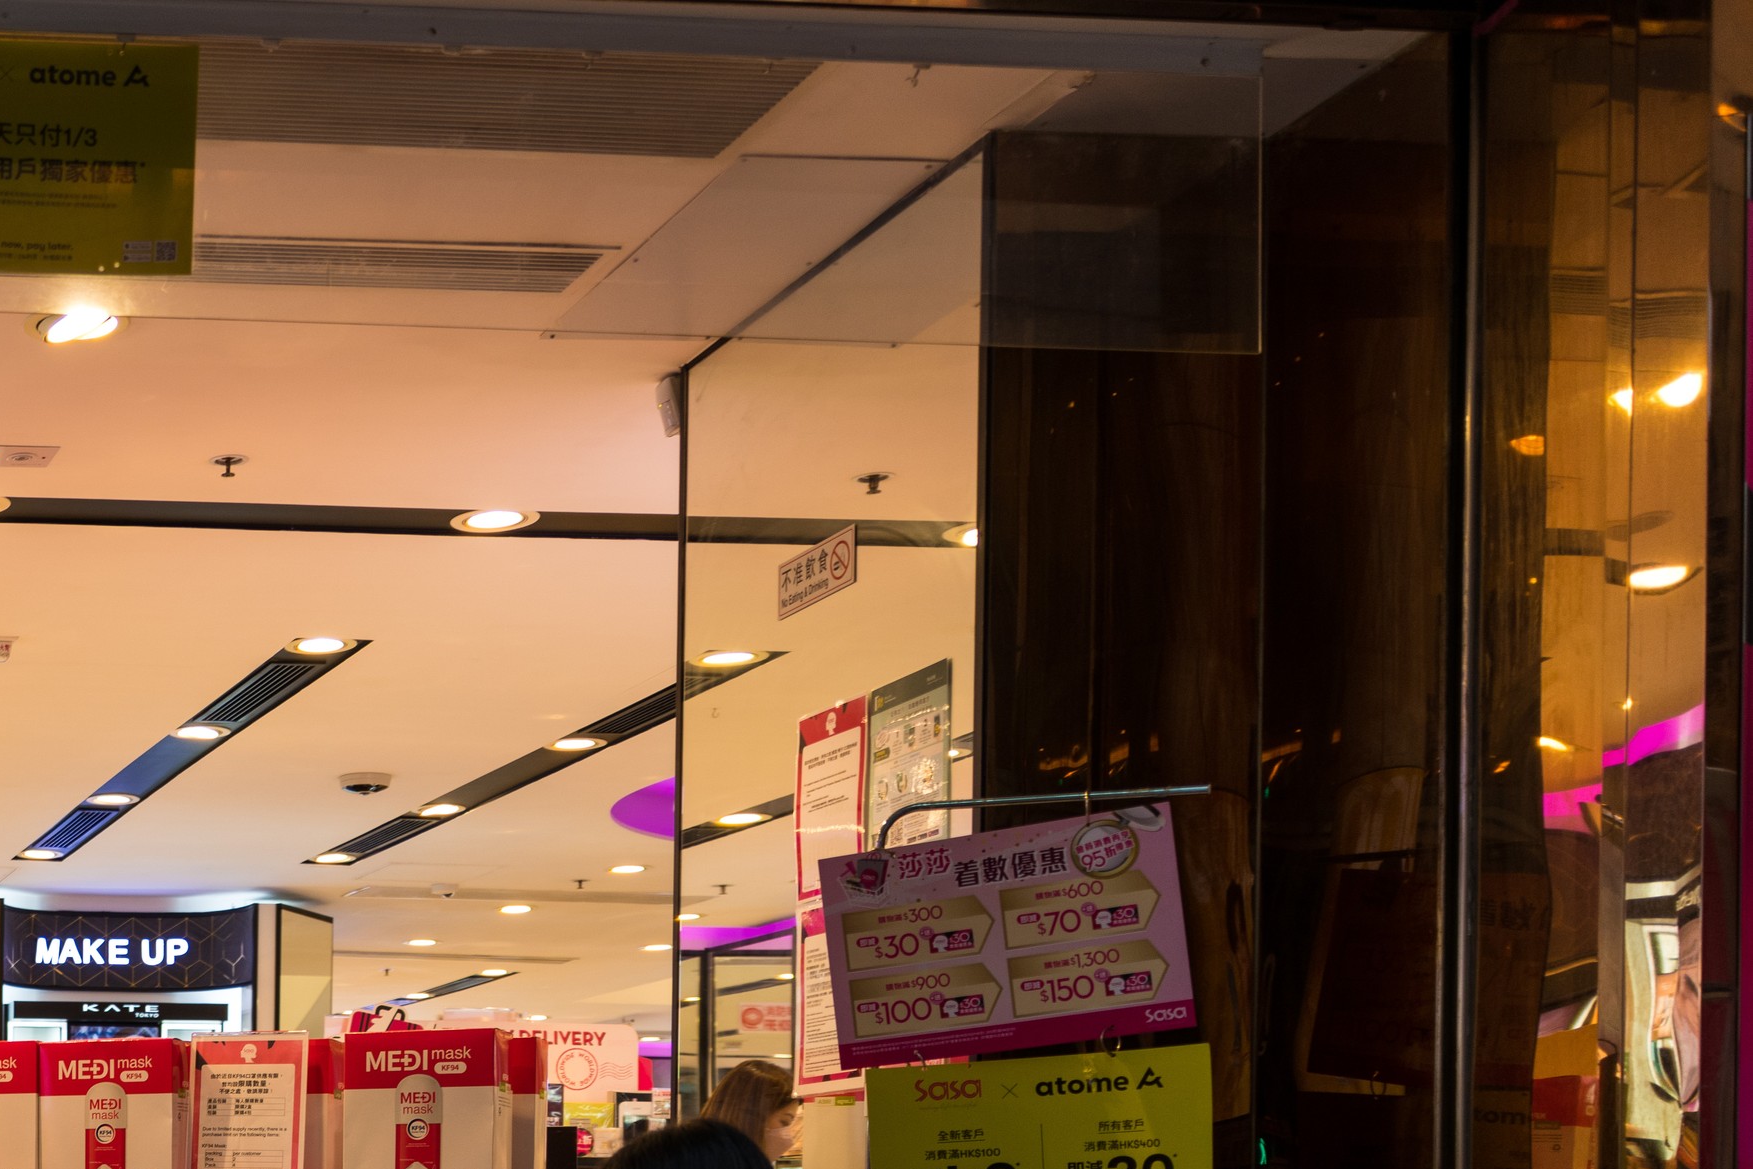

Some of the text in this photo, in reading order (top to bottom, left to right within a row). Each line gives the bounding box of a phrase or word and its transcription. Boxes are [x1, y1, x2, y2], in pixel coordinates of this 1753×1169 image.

[29, 66, 115, 86] atome
[27, 242, 45, 251] pay
[898, 848, 951, 879] 莎莎
[1037, 909, 1081, 936] $70
[35, 937, 189, 965] MAKE UP
[875, 933, 919, 959] $30
[1040, 975, 1094, 1003] $150
[82, 1003, 160, 1013] KATE
[875, 997, 932, 1025] $100
[431, 1046, 471, 1060] mask
[117, 1056, 152, 1069] mask
[441, 1064, 460, 1072] KF94
[126, 1072, 142, 1080] KF94
[1035, 1075, 1129, 1097] atome
[91, 1110, 119, 1120] mask
[402, 1103, 434, 1115] mask
[1098, 1119, 1145, 1132] 所有客戶
[937, 1129, 985, 1141] 全新客戶
